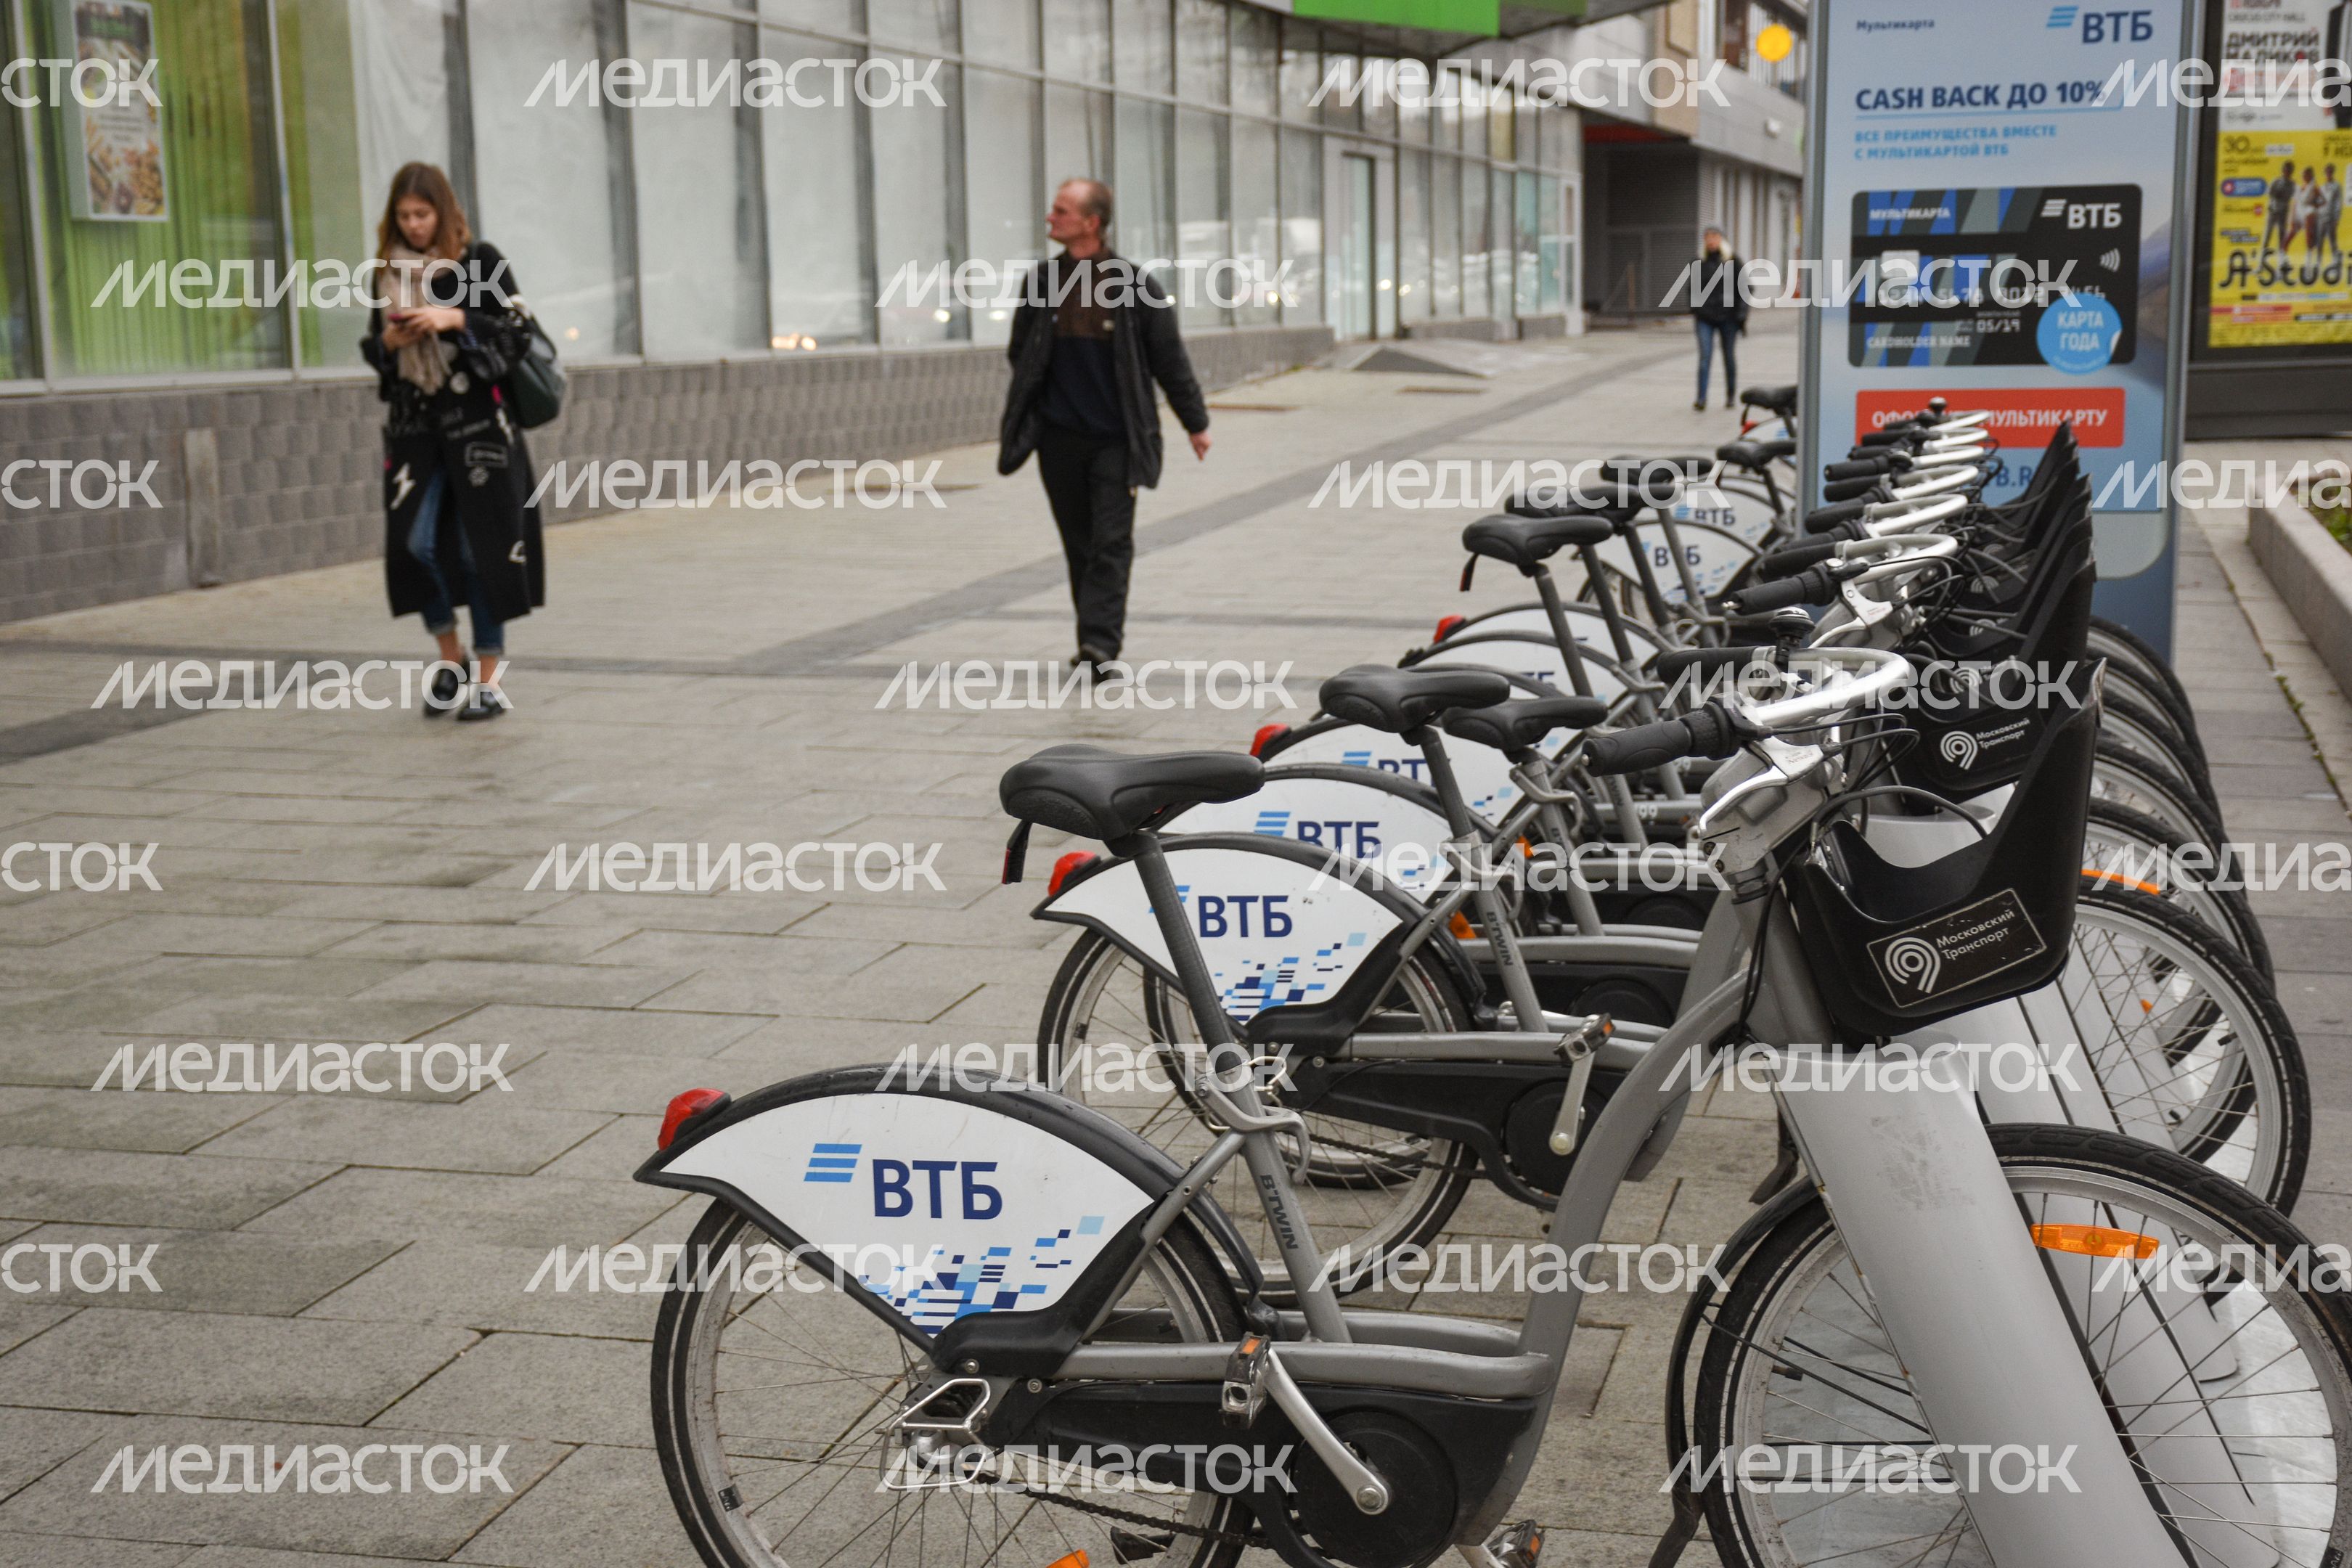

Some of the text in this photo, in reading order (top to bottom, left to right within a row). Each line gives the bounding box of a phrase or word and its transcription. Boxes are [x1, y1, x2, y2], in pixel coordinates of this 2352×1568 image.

[1857, 18, 1935, 33] Мультикарта
[2082, 10, 2153, 44] ВТБ
[2007, 83, 2047, 109] ДО
[2057, 81, 2107, 104] 10%
[1855, 125, 2057, 142] ВСЕ ПРЕИМУЩЕСТВА ВМЕСТЕ
[1855, 144, 2009, 160] С МУЛЬТИКАРТОЙ ВТБ
[1869, 207, 1951, 221] МУЛЬТИКАРТА
[2067, 203, 2122, 229] ВТБ
[1977, 319, 2021, 334] 05/19
[2057, 311, 2104, 328] КАРТА
[1867, 335, 1971, 349] CARDHOLDER NAME
[2060, 332, 2099, 351] ГОДА
[1654, 545, 1701, 568] ВБ
[1976, 717, 2031, 740] Московский
[1979, 730, 2025, 749] Транспорт
[1199, 894, 1293, 939] ВТБ
[1936, 909, 2016, 948] Московский
[1941, 928, 2009, 961] Транспорт
[872, 1157, 1003, 1221] ВТБ
